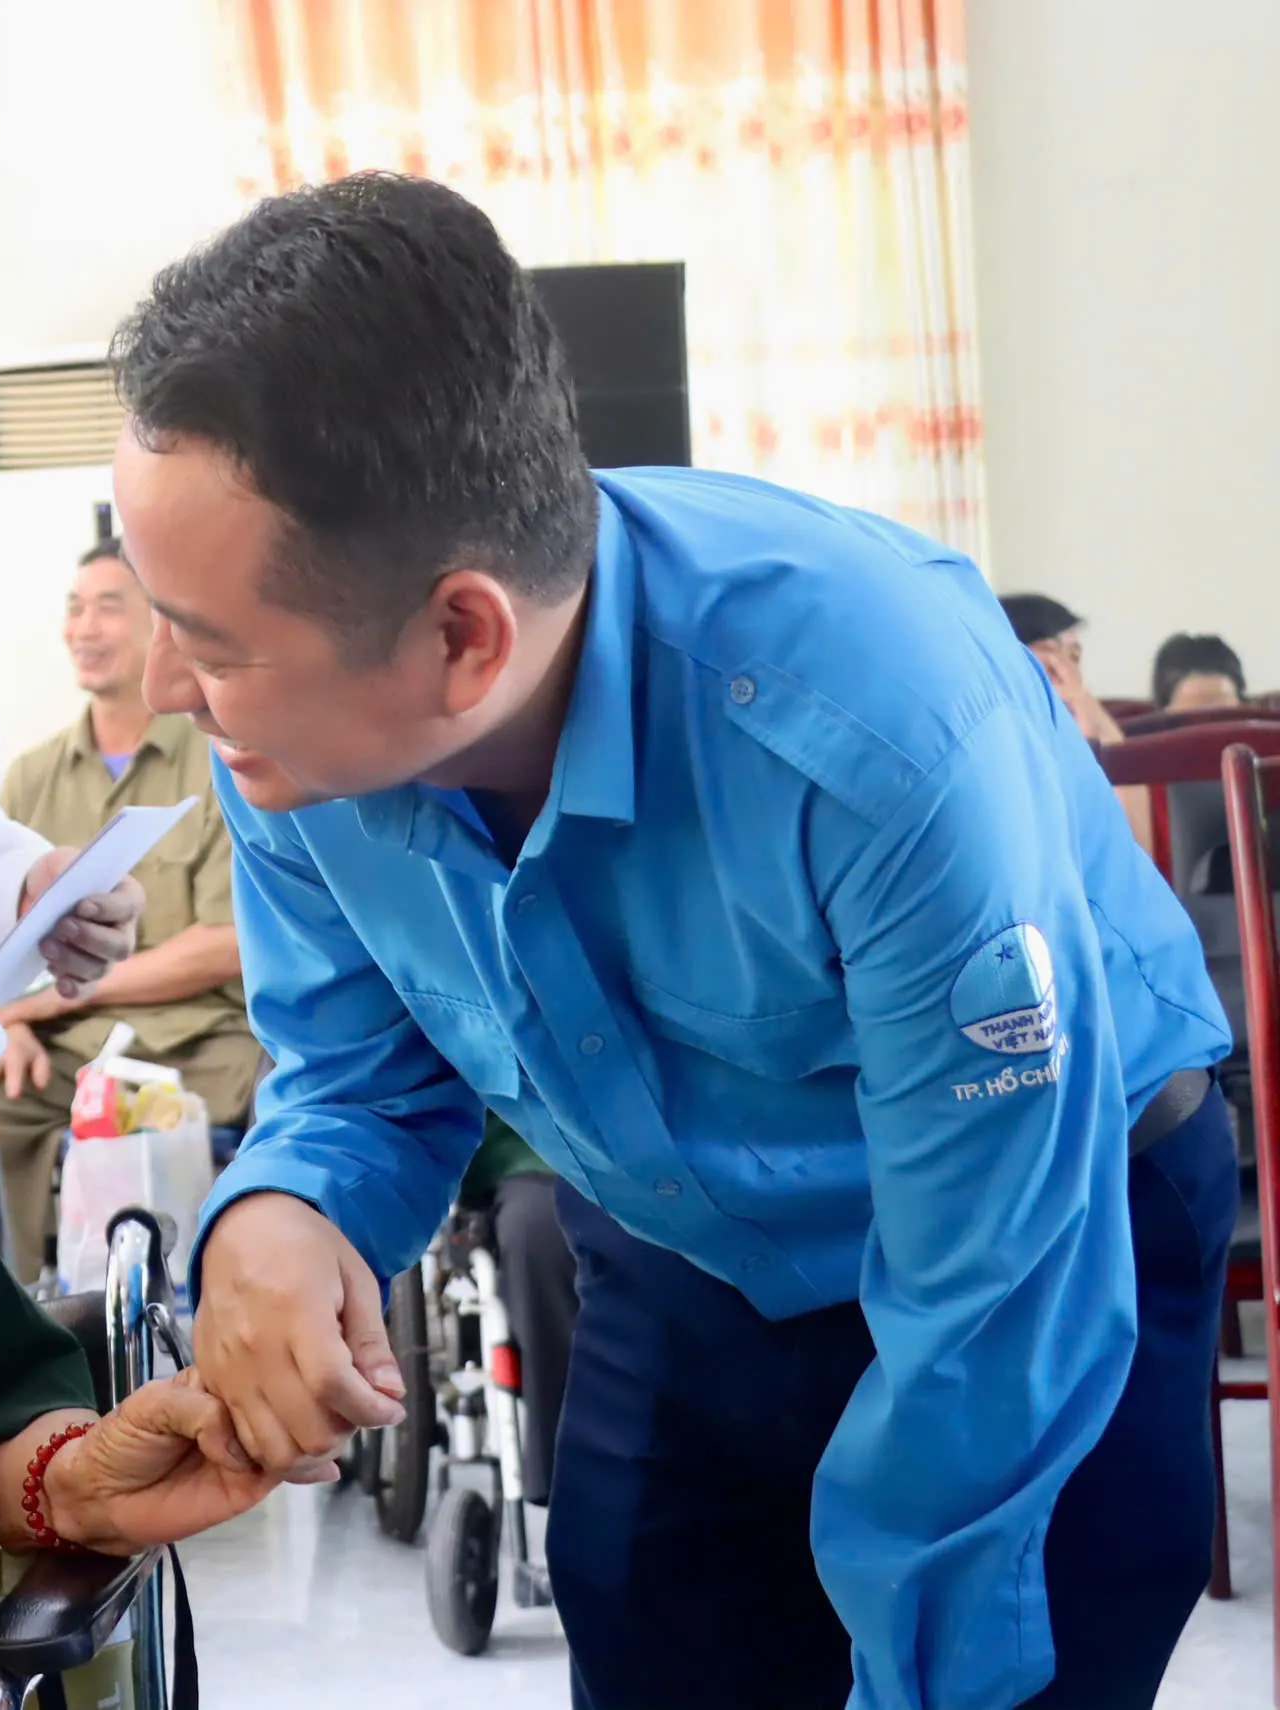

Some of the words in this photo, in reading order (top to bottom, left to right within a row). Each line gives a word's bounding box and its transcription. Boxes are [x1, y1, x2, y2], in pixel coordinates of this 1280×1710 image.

[980, 1014, 1035, 1037] THANH
[992, 1031, 1029, 1049] VIỆT
[951, 1083, 985, 1102] TP.
